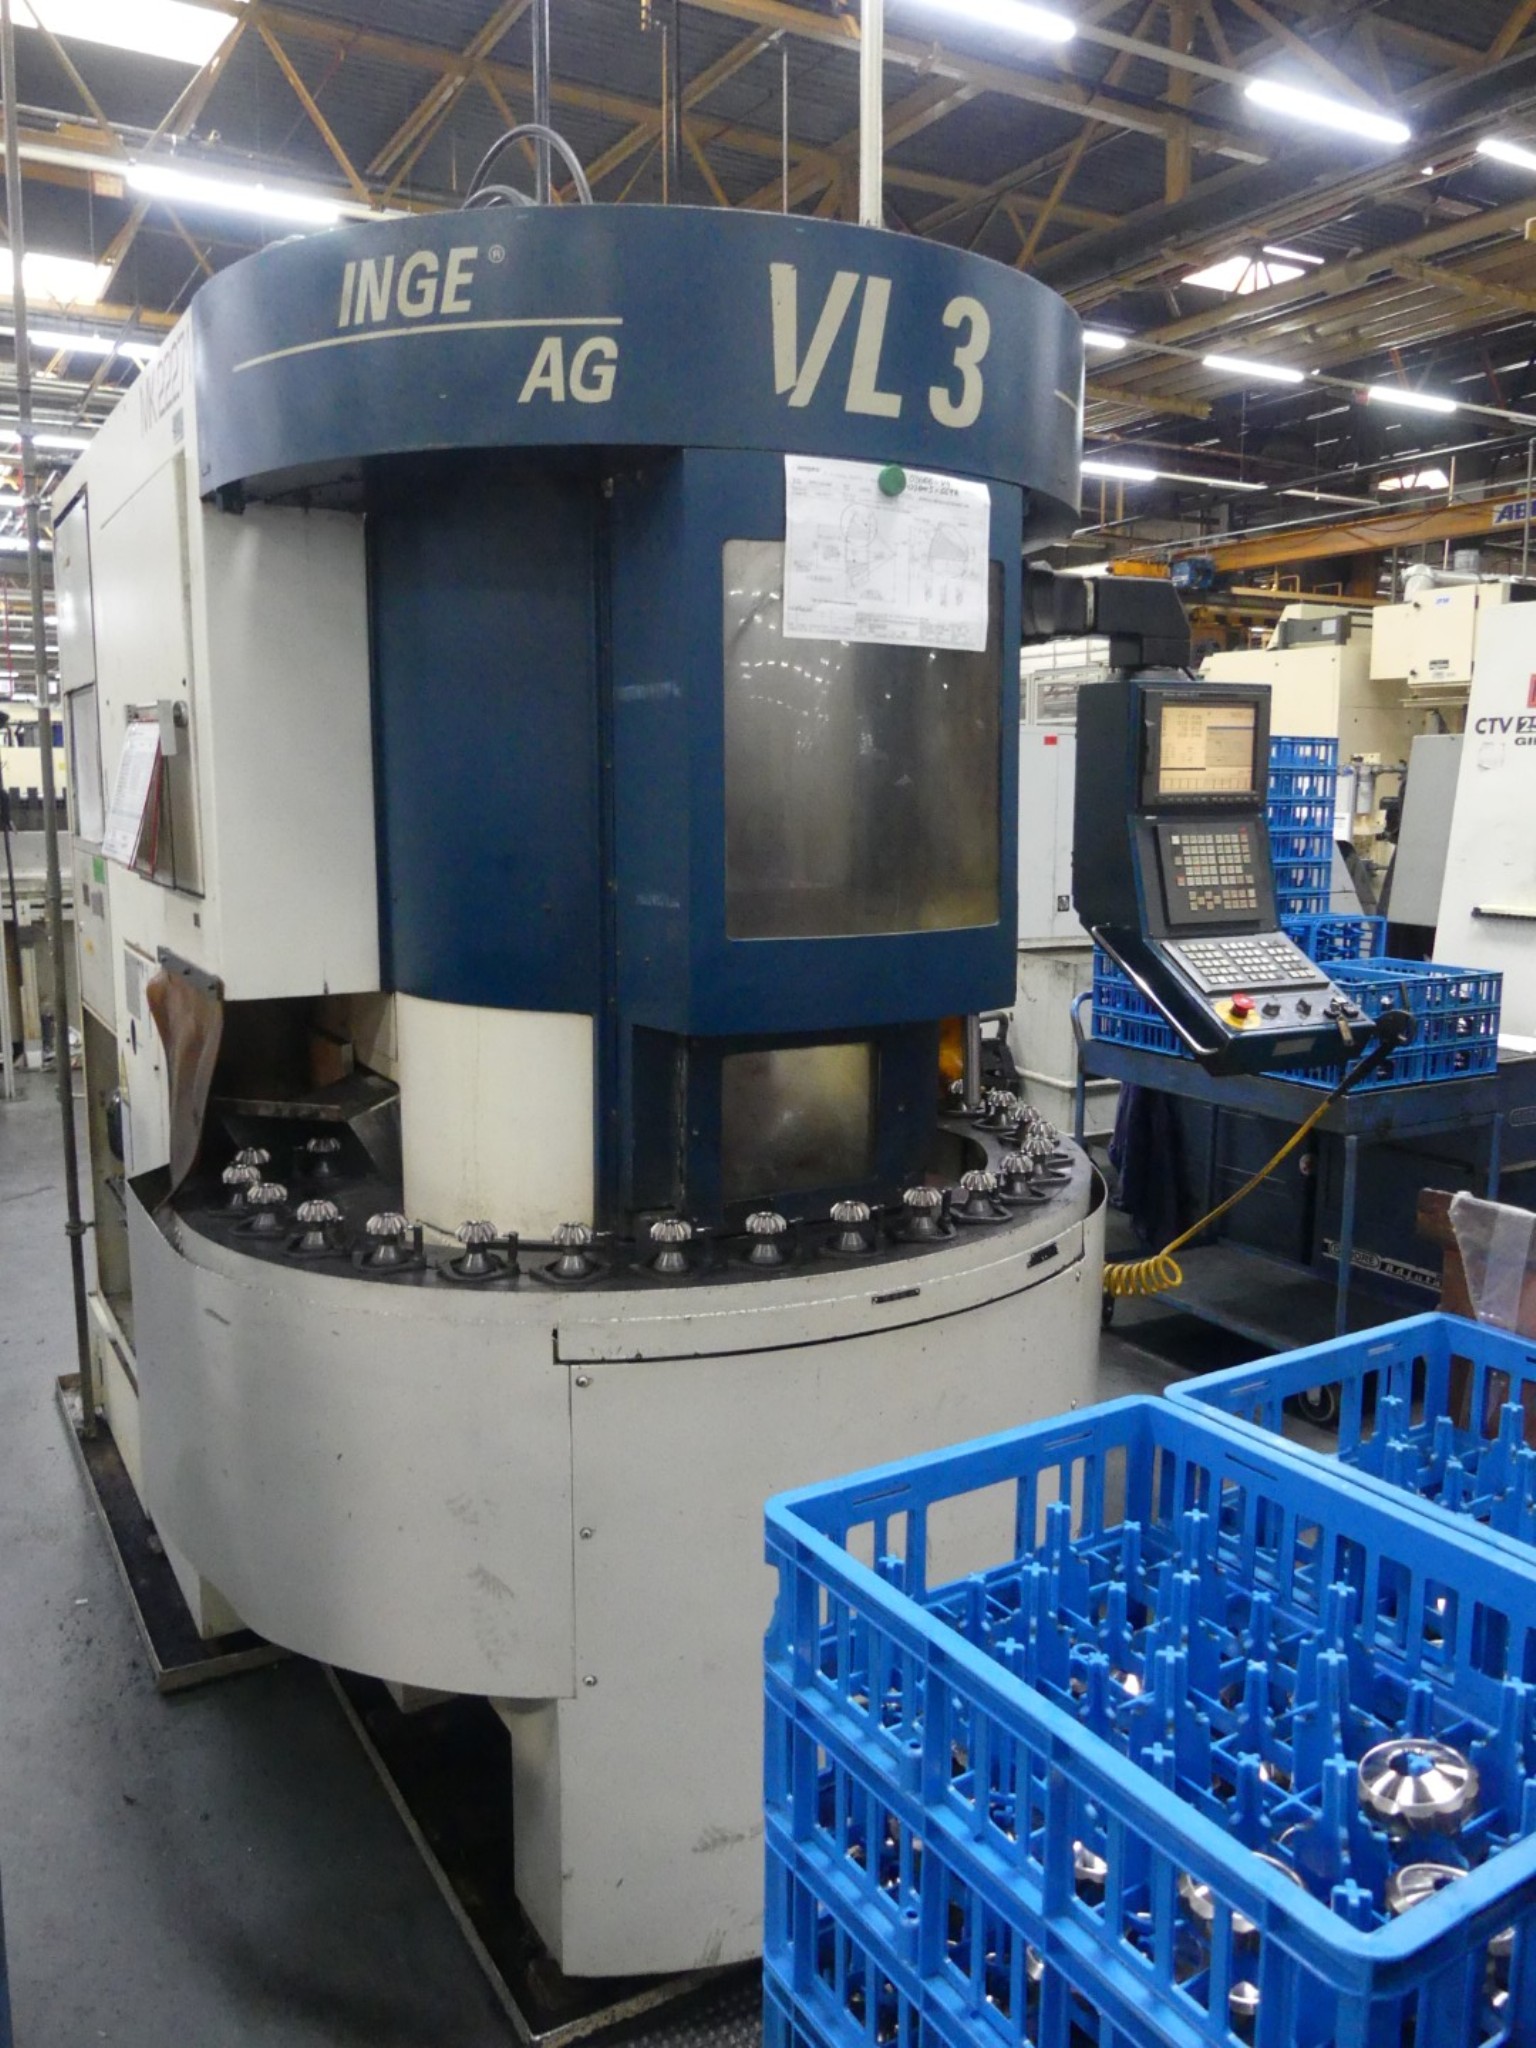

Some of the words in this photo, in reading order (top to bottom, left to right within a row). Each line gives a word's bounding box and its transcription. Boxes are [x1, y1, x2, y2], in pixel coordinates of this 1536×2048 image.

[338, 246, 478, 328] INGE
[769, 262, 902, 419] VL
[929, 296, 991, 429] 3
[517, 336, 619, 403] AG
[1495, 500, 1536, 524] AB
[1475, 716, 1514, 735] CTV
[1514, 737, 1536, 746] GI
